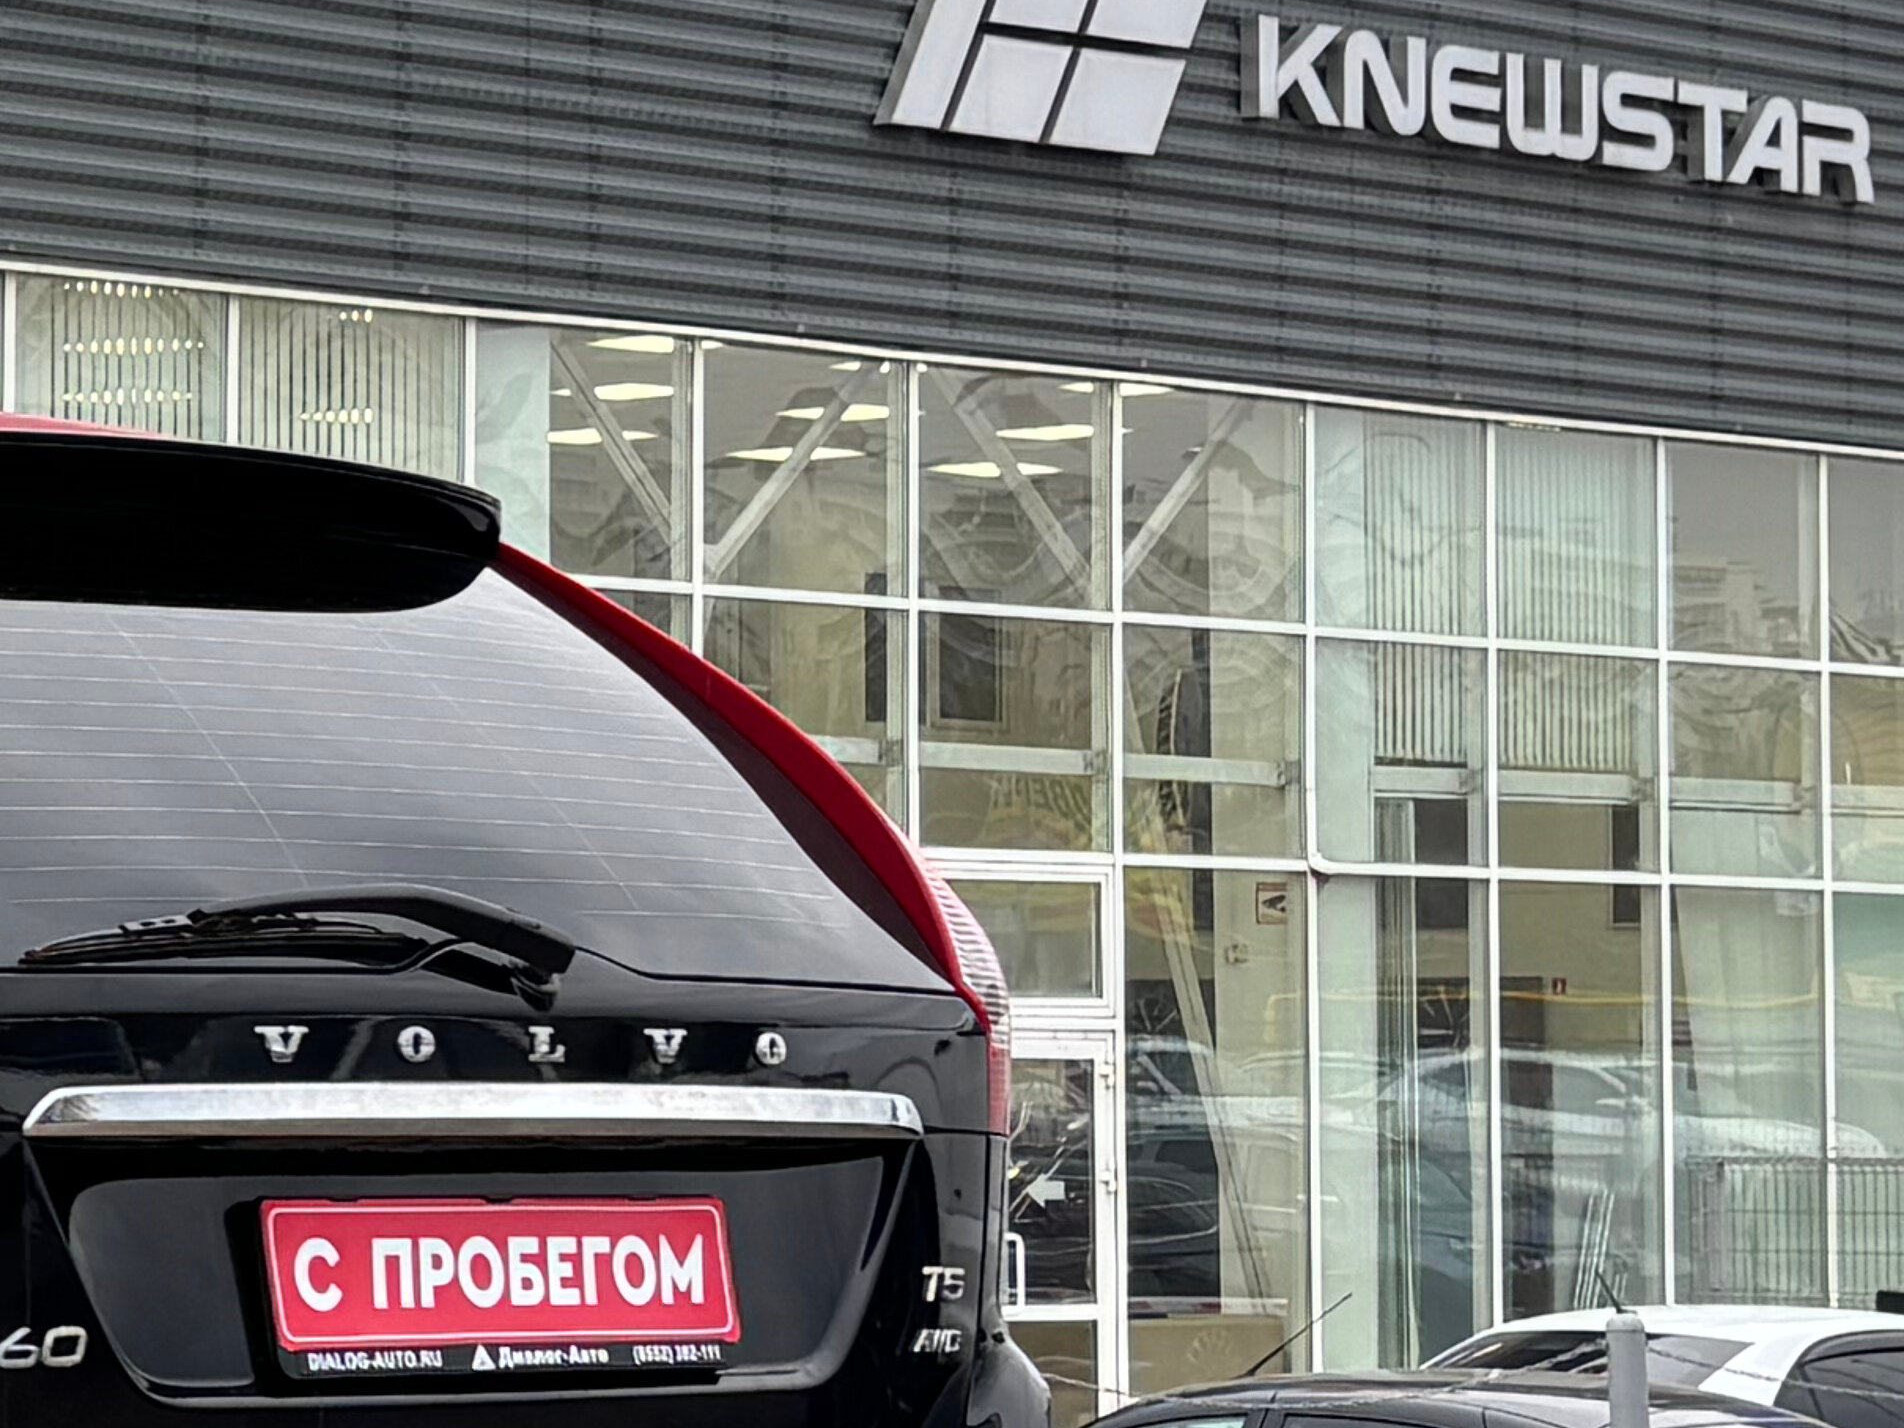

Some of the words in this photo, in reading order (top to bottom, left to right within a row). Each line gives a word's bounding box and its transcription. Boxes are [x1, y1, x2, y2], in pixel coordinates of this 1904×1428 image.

[1242, 14, 1875, 204] KNEWSTAR
[254, 1024, 788, 1066] VOLVO
[294, 1236, 343, 1312] С
[371, 1233, 705, 1310] ПРОБЕГОМ
[921, 1265, 966, 1302] T5
[306, 1349, 443, 1371] DIALOG-AUTO.RU
